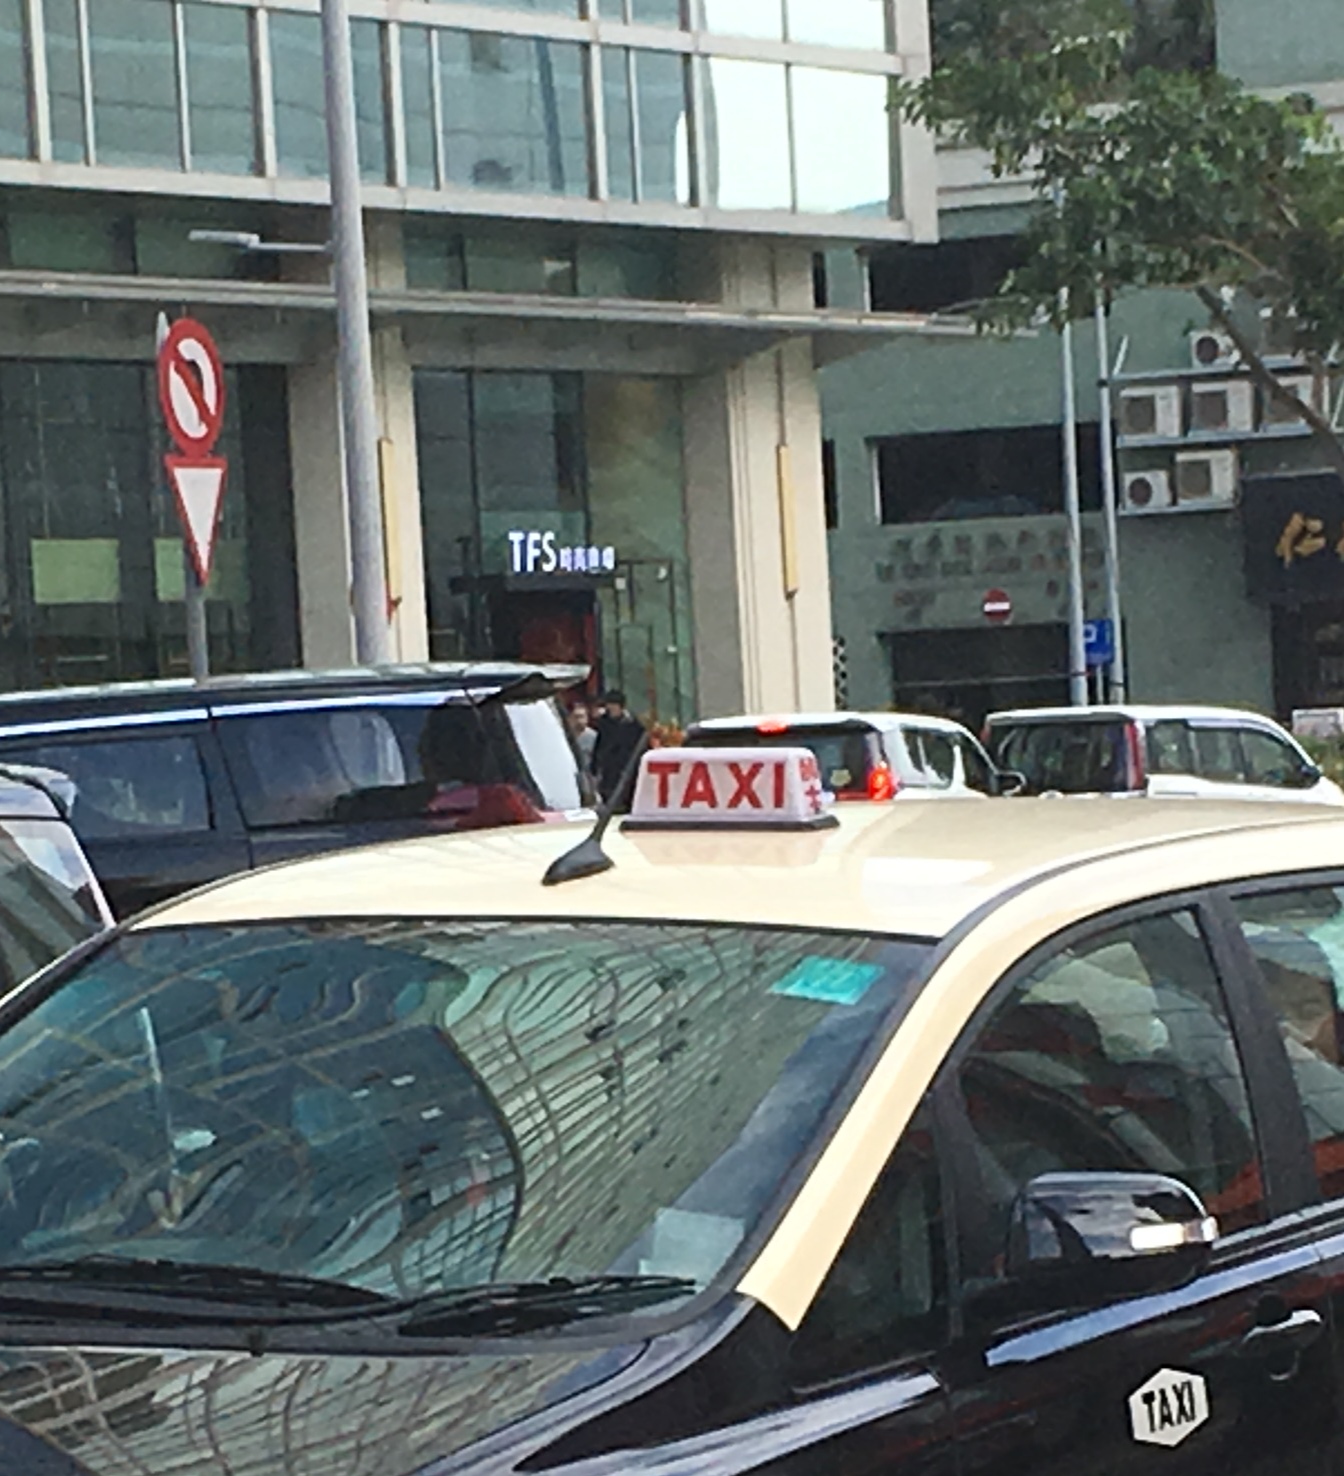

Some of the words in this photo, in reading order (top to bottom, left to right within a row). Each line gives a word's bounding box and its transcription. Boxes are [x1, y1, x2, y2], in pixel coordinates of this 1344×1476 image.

[508, 530, 557, 573] TFS
[647, 761, 787, 809] TAXI
[1141, 1380, 1197, 1433] TAXI
